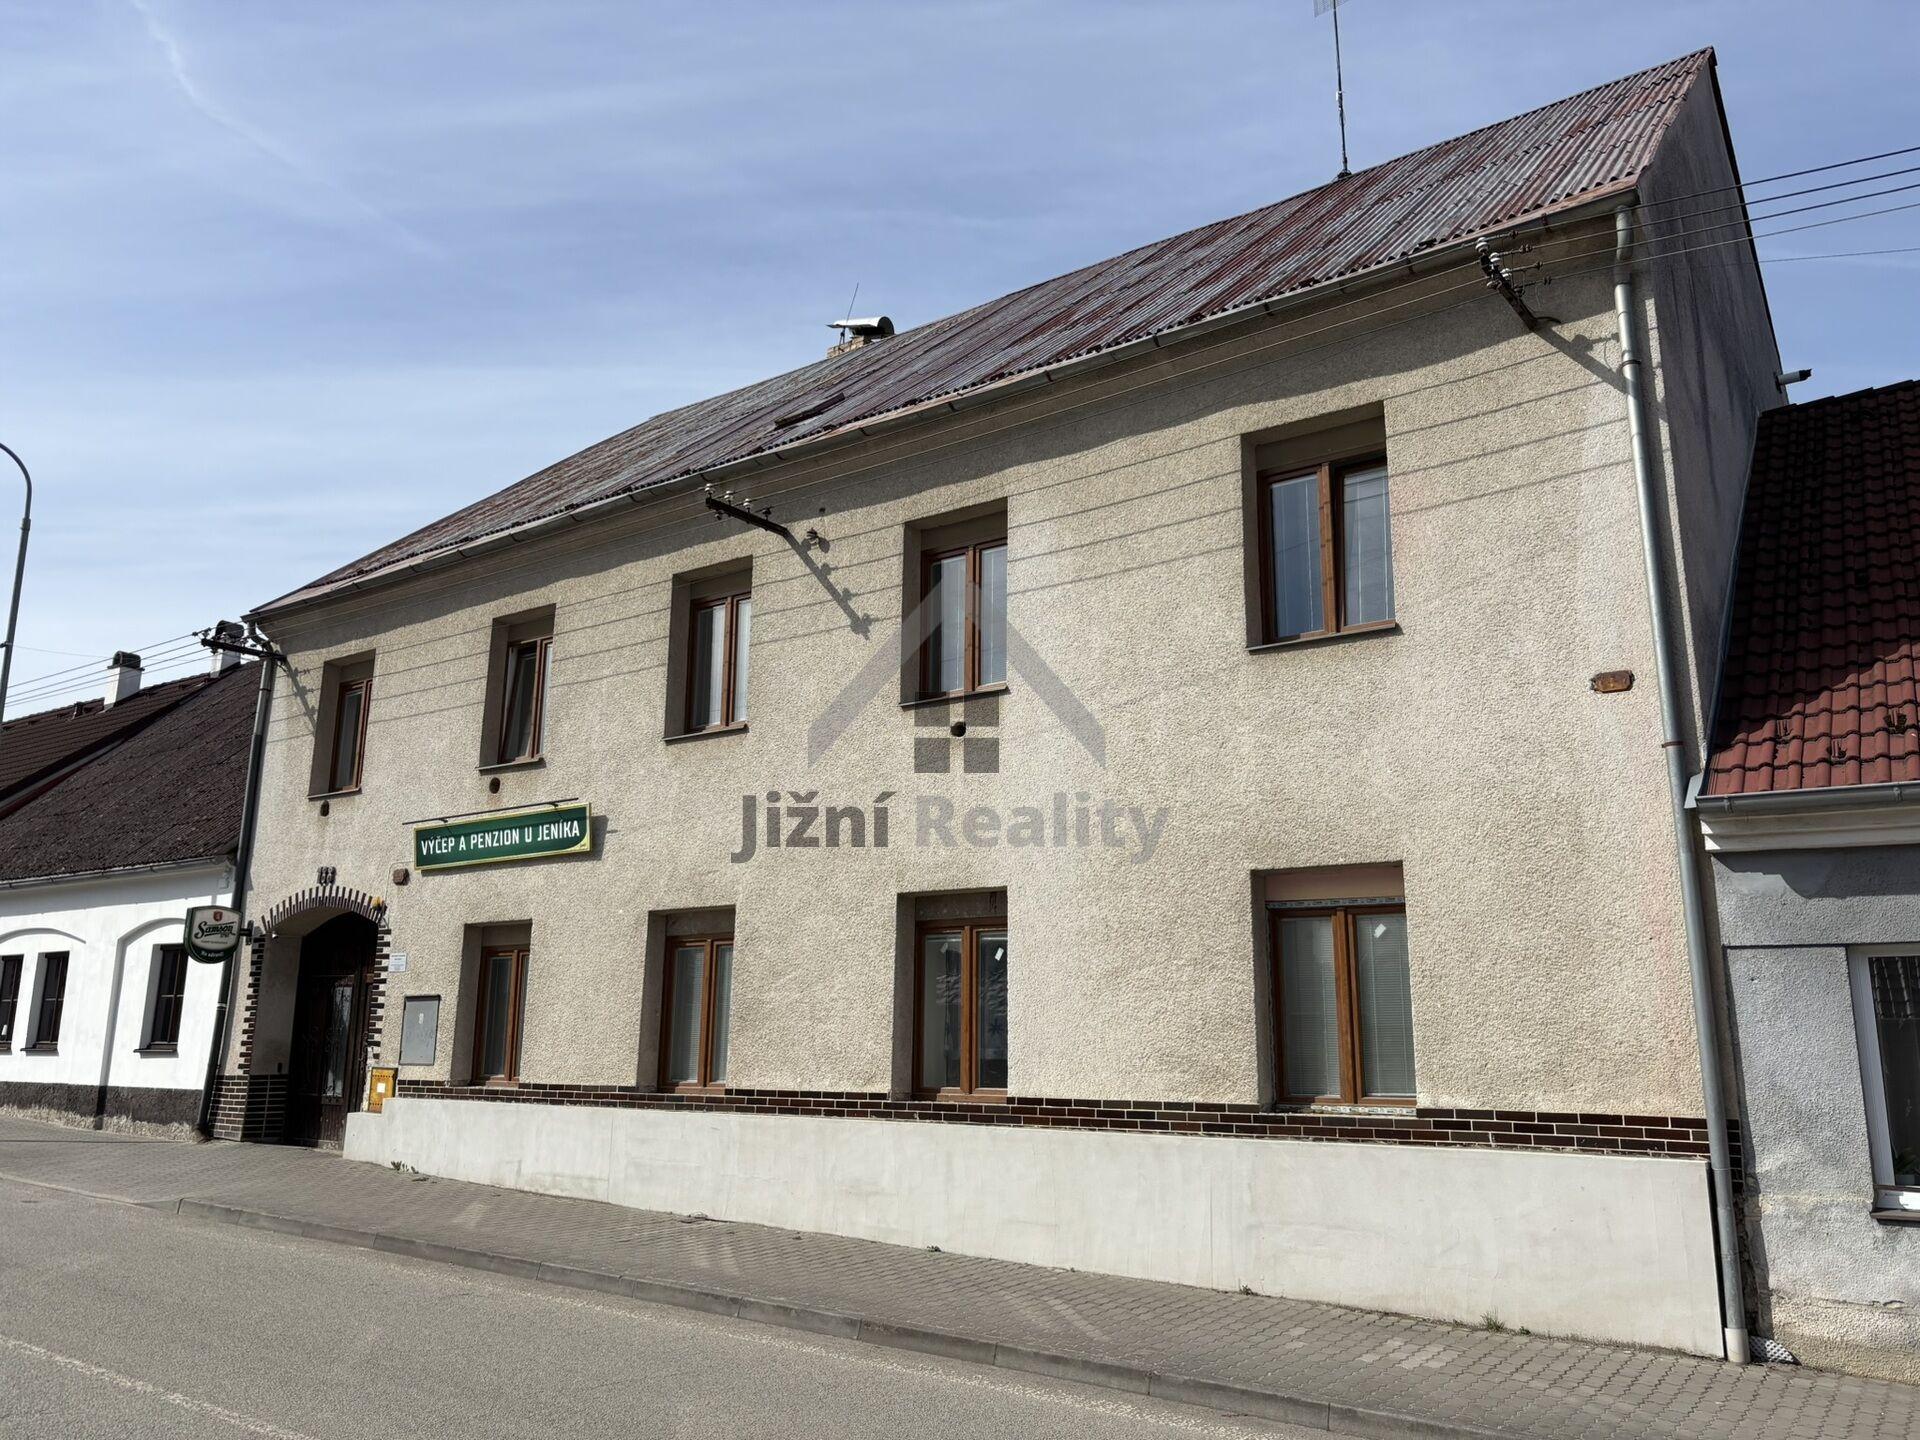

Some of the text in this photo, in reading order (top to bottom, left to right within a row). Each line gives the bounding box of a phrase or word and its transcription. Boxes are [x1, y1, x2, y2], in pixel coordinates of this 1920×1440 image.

[421, 820, 580, 856] VÝČEP A PENZION U JENÍKA
